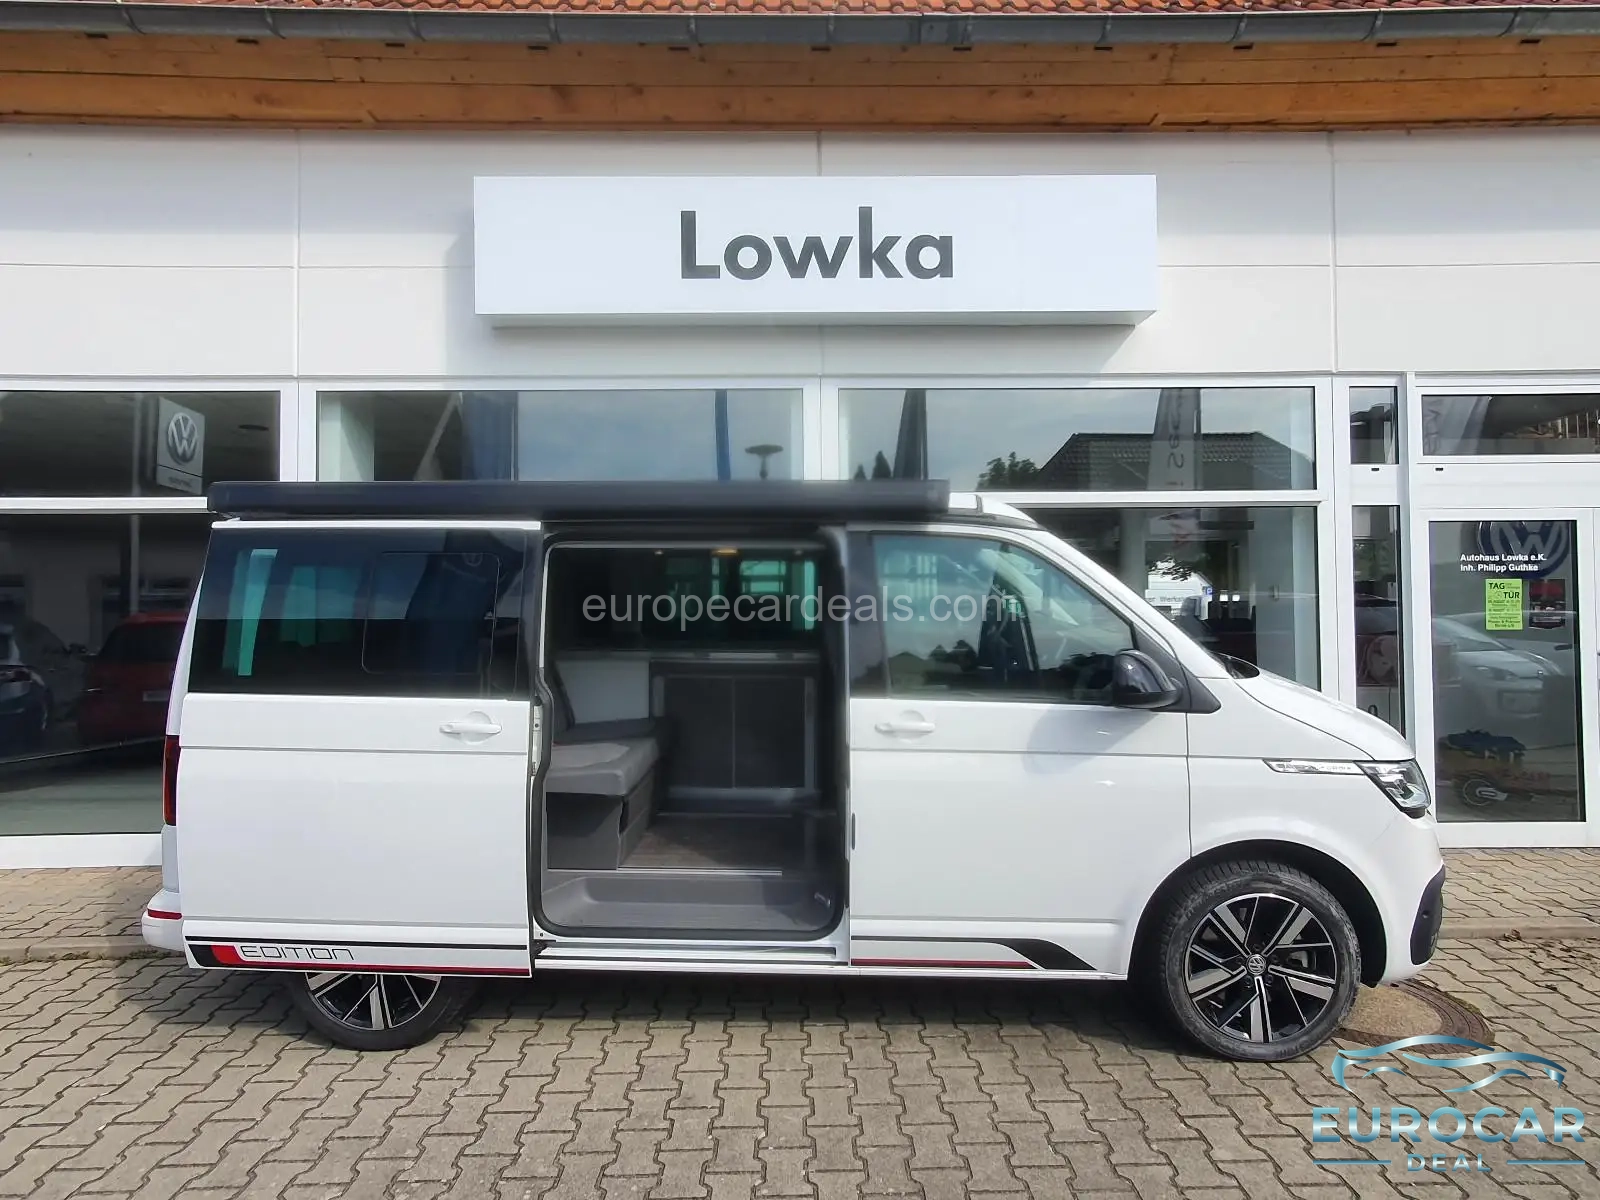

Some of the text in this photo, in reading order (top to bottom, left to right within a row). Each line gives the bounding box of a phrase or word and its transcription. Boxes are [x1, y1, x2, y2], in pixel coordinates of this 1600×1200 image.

[680, 206, 954, 280] Lowka
[1478, 564, 1507, 573] Philipp
[1488, 582, 1505, 590] TAG
[1503, 590, 1520, 599] TÜR
[240, 945, 355, 961] EDITION
